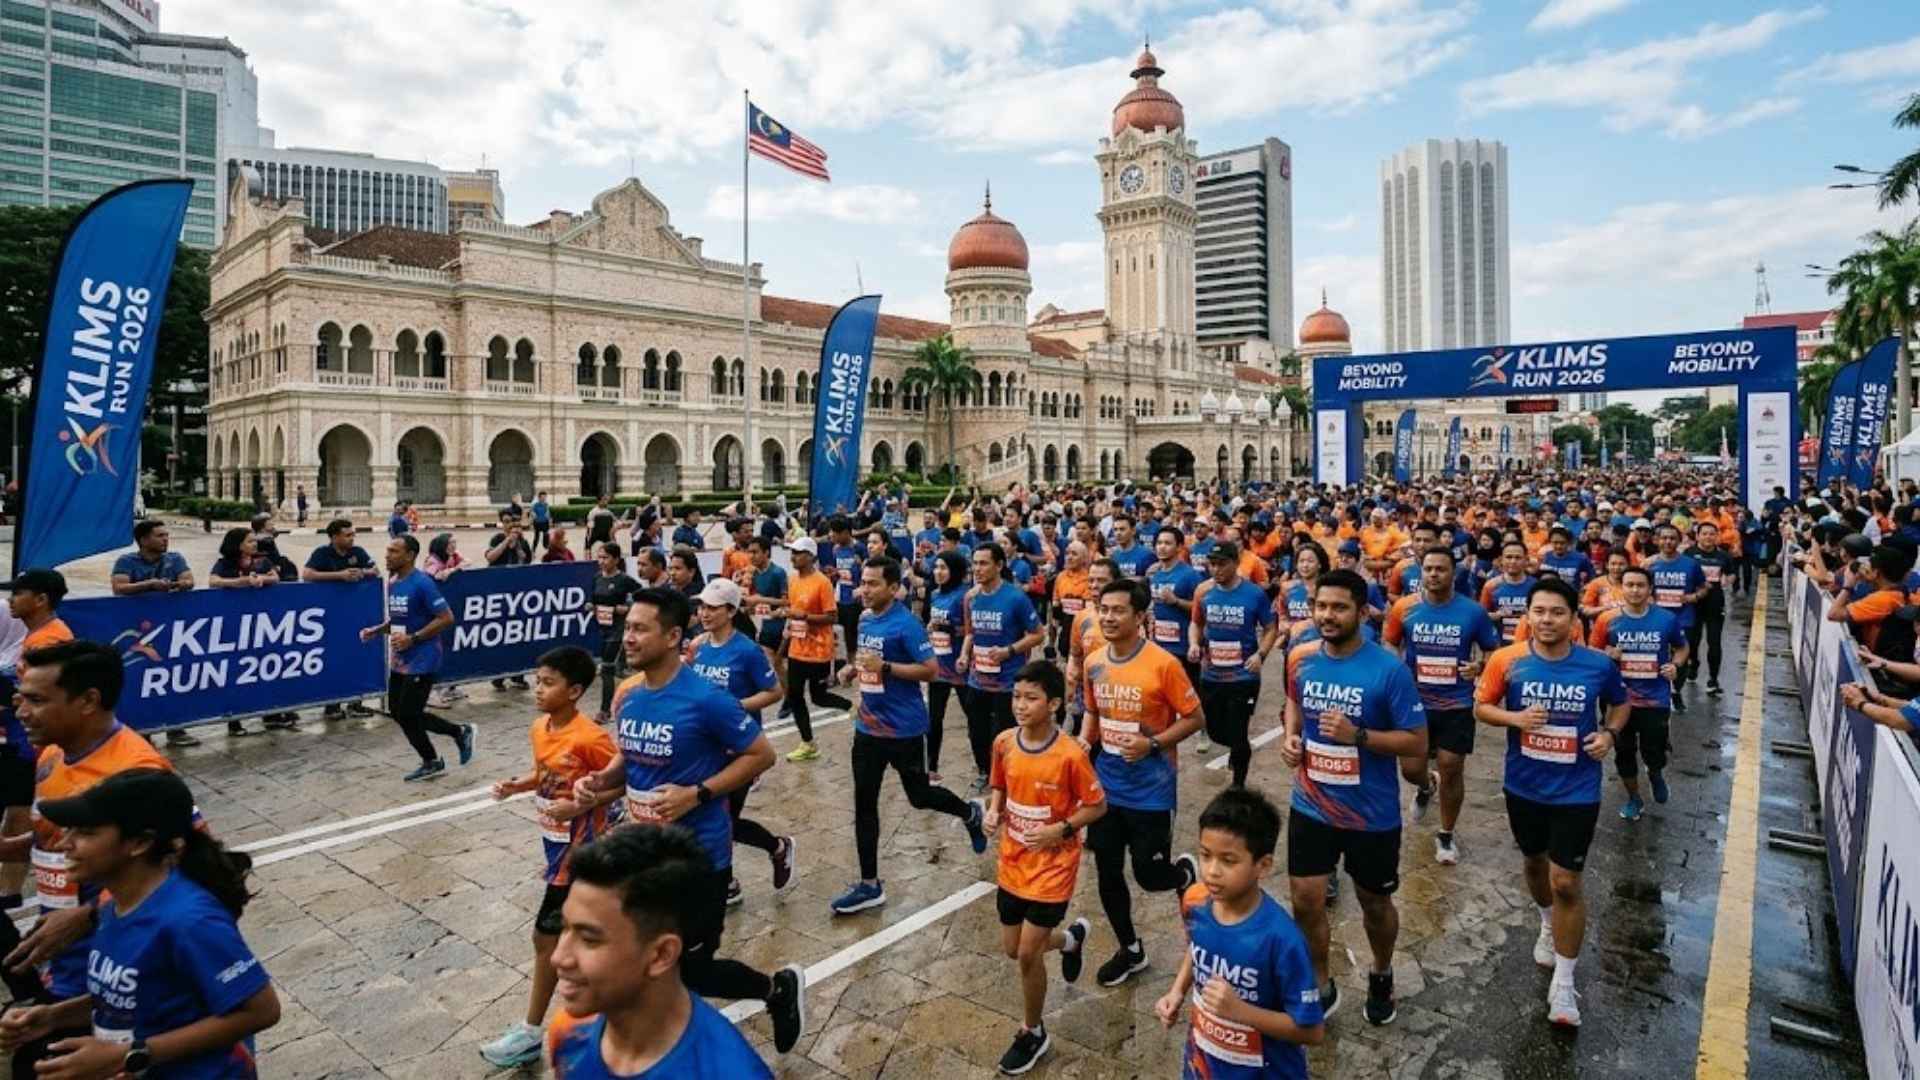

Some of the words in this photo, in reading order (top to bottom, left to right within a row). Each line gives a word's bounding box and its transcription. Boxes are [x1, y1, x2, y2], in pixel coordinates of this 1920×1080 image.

[118, 287, 151, 354] 2026
[64, 278, 121, 418] KLIMS
[1516, 344, 1608, 370] KLIMS
[1674, 340, 1754, 358] BEYOND
[1342, 361, 1404, 378] BEYOND
[1668, 355, 1761, 374] MOBILITY
[110, 362, 134, 413] RUN
[1338, 375, 1408, 391] MOBILITY
[1511, 372, 1553, 388] RUN
[1557, 369, 1606, 386] 2026
[824, 351, 850, 434] KLIMS
[463, 586, 585, 621] BEYOND
[168, 607, 326, 659] KLIMS
[452, 610, 594, 651] MOBILITY
[141, 658, 229, 698] RUN
[236, 647, 325, 685] 2026
[1303, 680, 1364, 704] KLIMS
[1522, 681, 1587, 700] KLIMS
[620, 718, 674, 743] KLIMS
